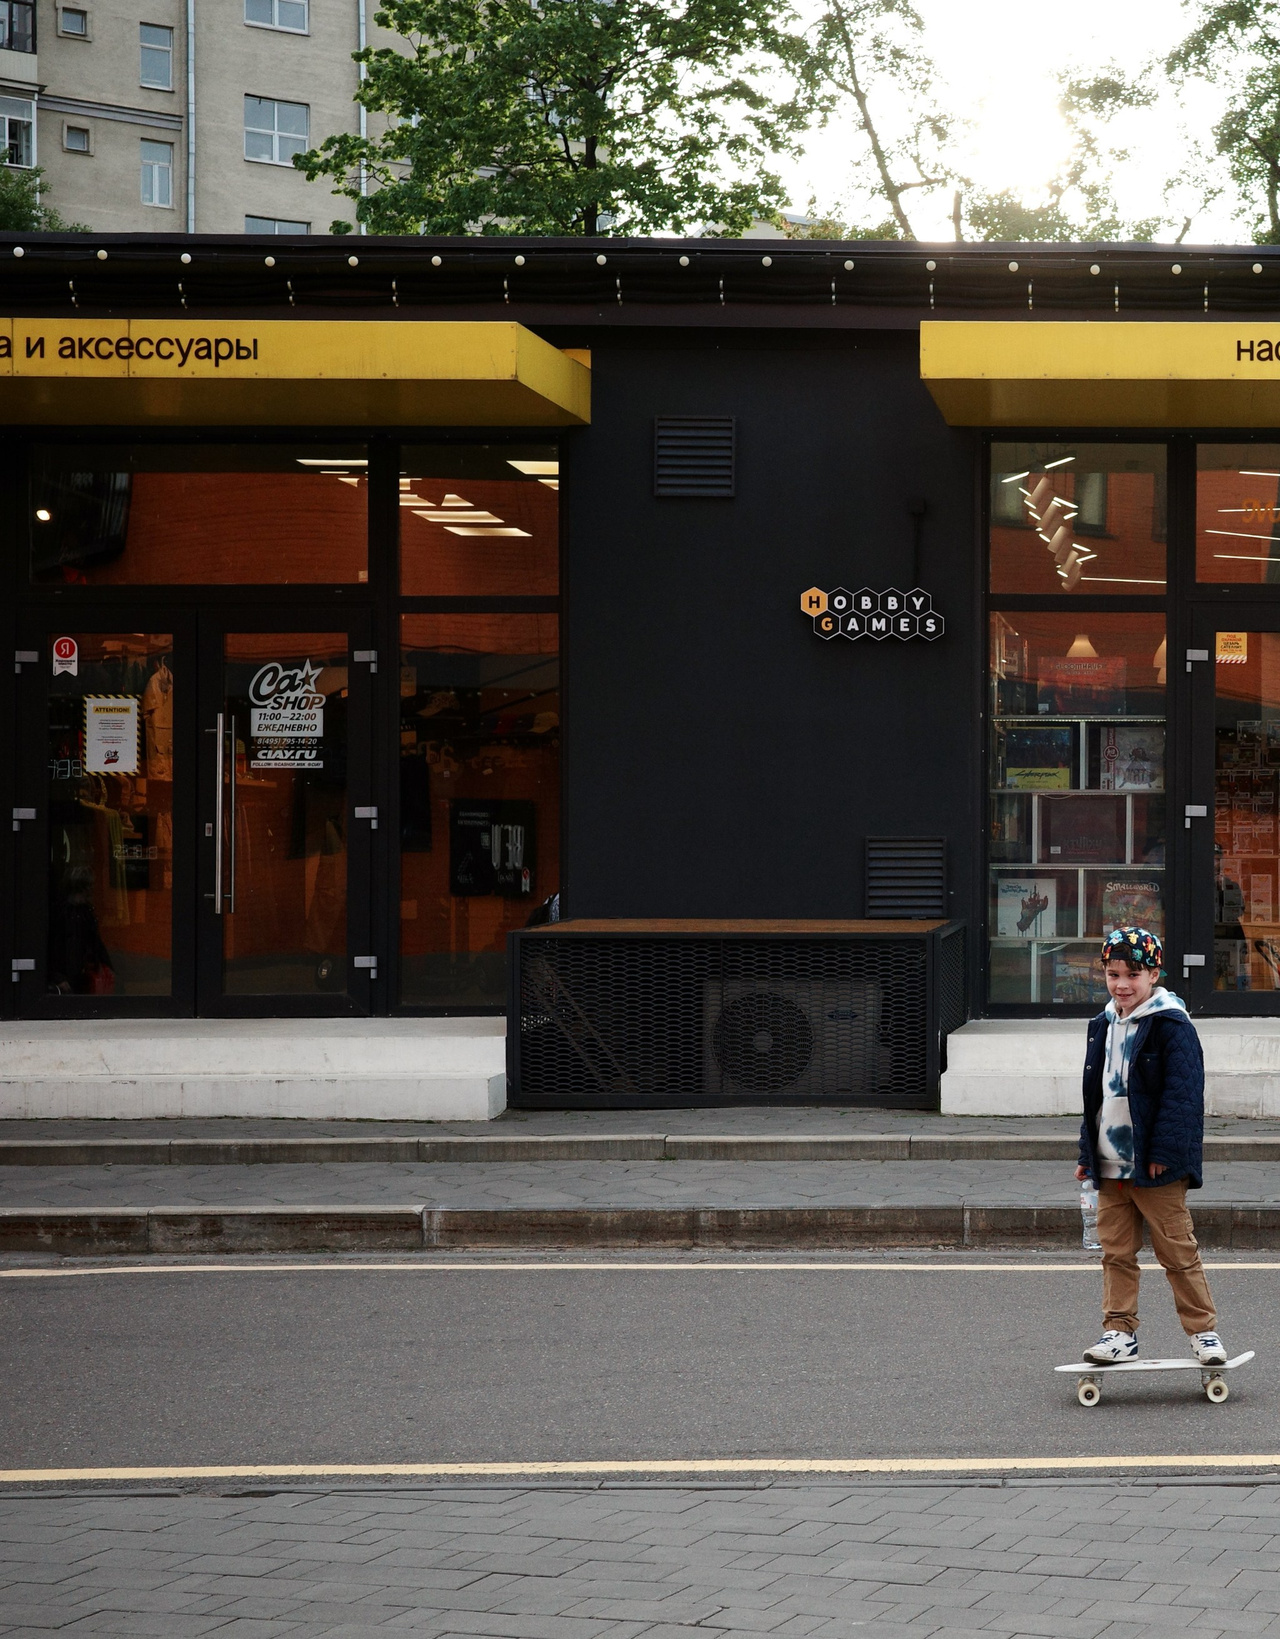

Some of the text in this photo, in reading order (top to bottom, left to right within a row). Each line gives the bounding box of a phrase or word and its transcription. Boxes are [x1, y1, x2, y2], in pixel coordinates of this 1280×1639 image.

[25, 337, 45, 359] и
[58, 336, 258, 367] аксессуары
[808, 595, 925, 611] HOBBY
[821, 617, 937, 633] GAMES
[60, 642, 70, 655] Я
[270, 695, 325, 711] SHOP
[257, 723, 318, 733] ЕЖЕДНЕВНО
